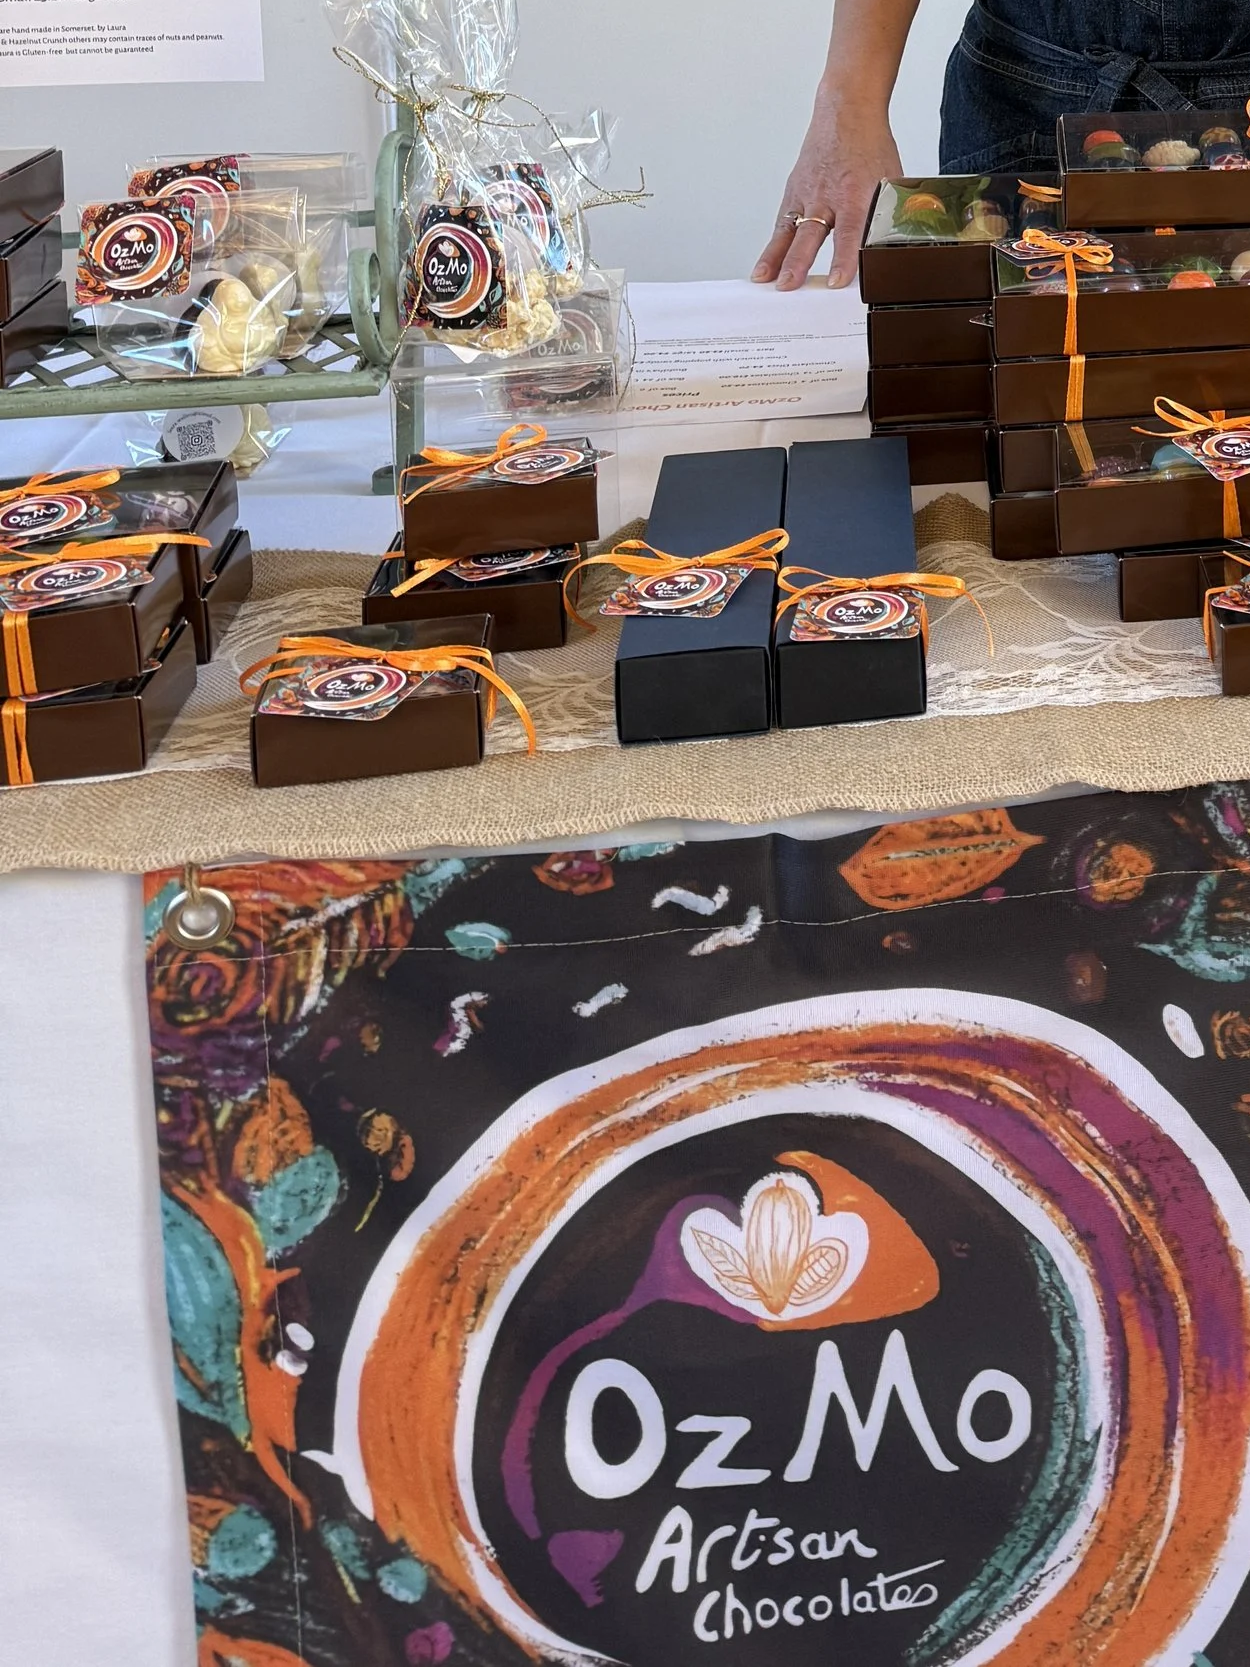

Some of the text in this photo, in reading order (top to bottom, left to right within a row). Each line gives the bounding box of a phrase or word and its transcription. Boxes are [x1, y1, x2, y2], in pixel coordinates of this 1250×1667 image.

[111, 242, 154, 259] OzMo
[428, 257, 468, 276] OzMo
[564, 1329, 1032, 1499] OzMo
[635, 1506, 877, 1594] Artisan
